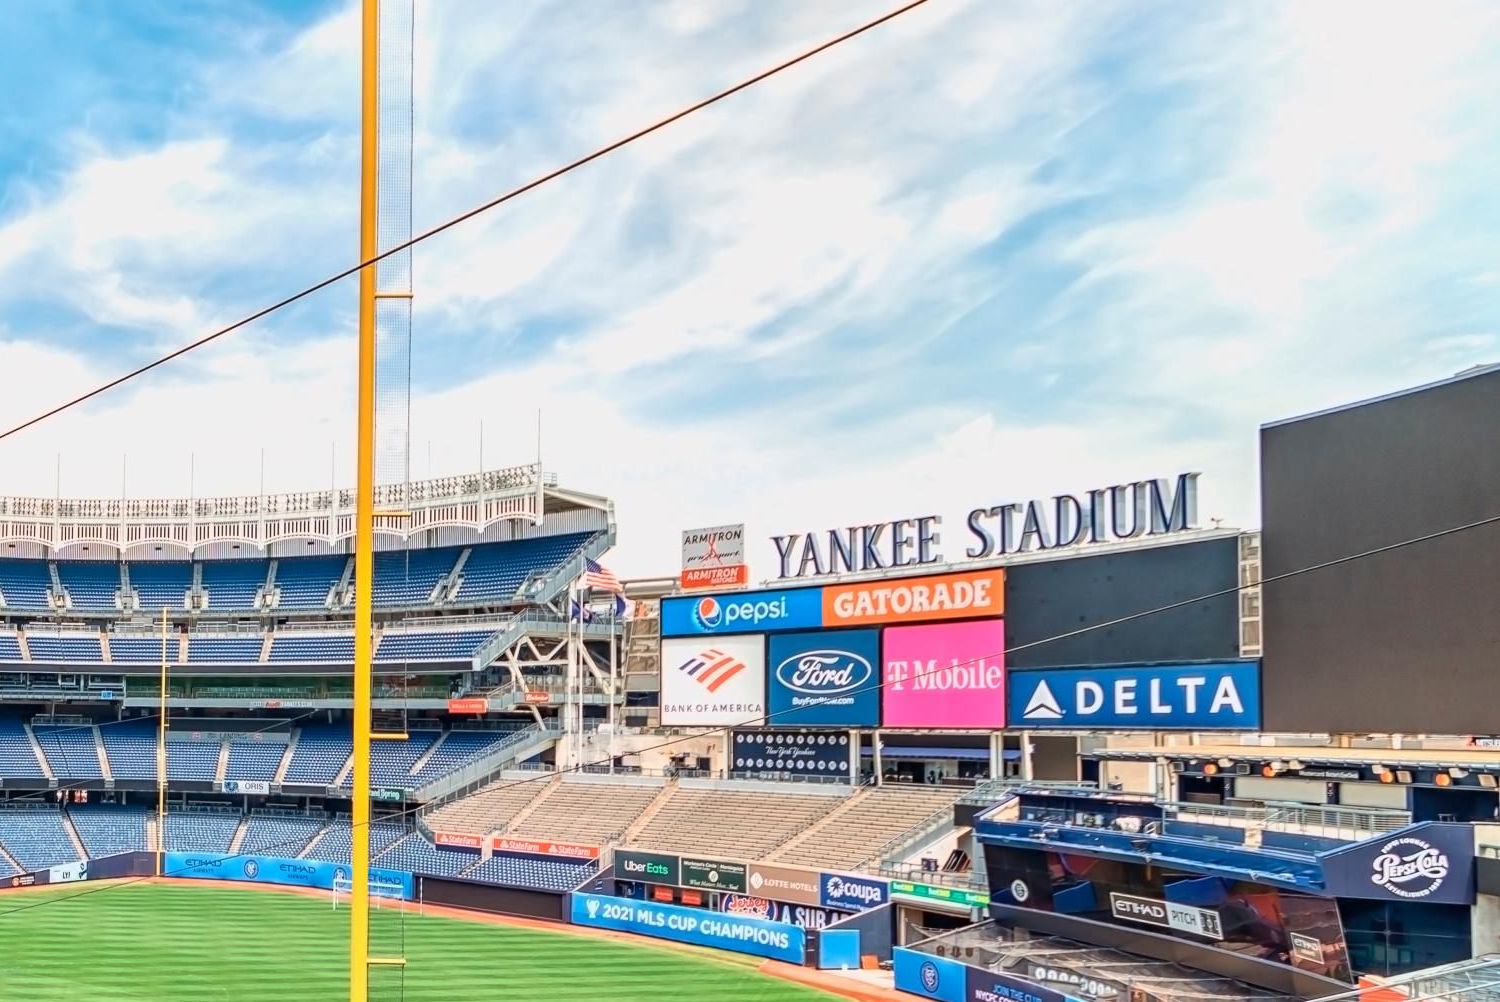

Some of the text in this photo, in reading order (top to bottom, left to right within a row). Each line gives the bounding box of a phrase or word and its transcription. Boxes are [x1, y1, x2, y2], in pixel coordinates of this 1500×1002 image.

[769, 471, 1202, 579] YANKEE STADIUM
[683, 529, 743, 546] ARMITRON
[686, 567, 740, 582] ARMITRON
[833, 579, 992, 619] GATORADE
[724, 596, 788, 627] pepsi
[791, 656, 855, 687] Ford
[911, 659, 1002, 691] Mobile
[792, 696, 855, 707] BuyFordNow.com
[1075, 675, 1244, 717] DELTA
[664, 703, 762, 714] BANK OF AMERICA
[381, 789, 400, 800] Spring
[185, 858, 222, 867] ETIHAD
[279, 863, 317, 875] ETIHAD
[624, 860, 669, 875] Uber Eats
[764, 879, 818, 893] LOTTE HOTELS
[843, 882, 882, 904] coupa
[729, 893, 770, 912] Jersey
[781, 905, 791, 924] A
[795, 907, 827, 930] SUB
[1114, 900, 1197, 926] ETIHAD PITCH
[602, 903, 789, 949] 2021 MLS CUP CHAMPIONS
[1293, 938, 1318, 951] ETIHAD
[991, 984, 1010, 998] JOIN
[1010, 988, 1025, 1001] THE
